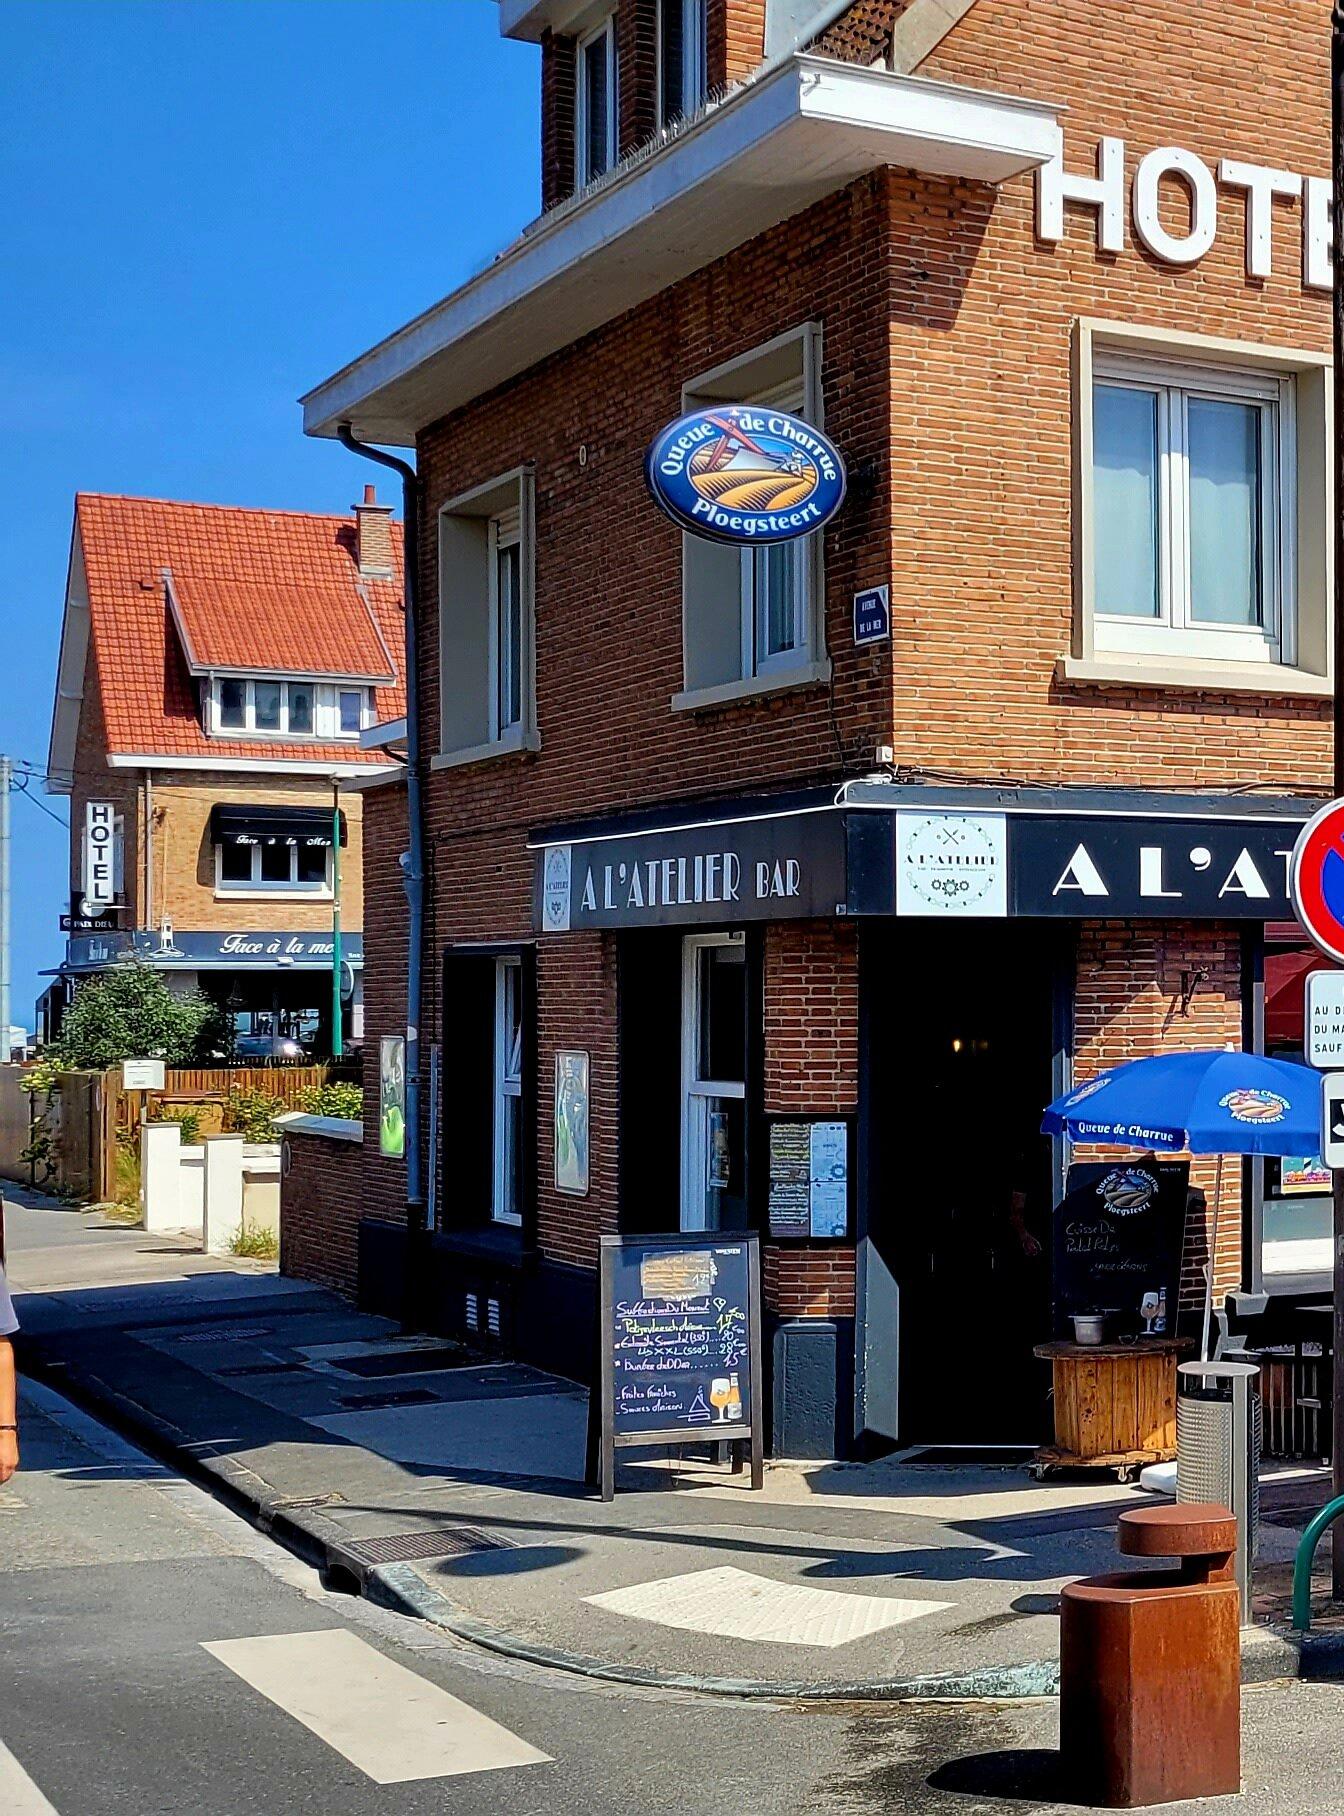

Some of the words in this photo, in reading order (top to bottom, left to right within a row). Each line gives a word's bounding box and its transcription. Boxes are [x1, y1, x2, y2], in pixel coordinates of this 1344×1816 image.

[661, 423, 715, 476] Queue
[739, 413, 765, 431] de
[768, 417, 837, 481] Charrue
[691, 497, 822, 536] Ploegsteert
[91, 806, 110, 899] HOTEL
[1052, 842, 1110, 896] A
[581, 865, 597, 912] A
[604, 852, 740, 910] L'ATELIER
[756, 859, 801, 899] BAR
[219, 934, 263, 954] Face
[267, 938, 282, 954] à
[286, 936, 305, 954] la
[308, 943, 335, 954] me
[1314, 1006, 1328, 1016] AU
[1314, 1025, 1328, 1034] DU
[1314, 1043, 1342, 1053] SAUF
[1078, 1122, 1110, 1134] Queue
[1113, 1124, 1126, 1134] de
[1128, 1126, 1174, 1142] Charrue
[1126, 1168, 1136, 1176] de
[1104, 1202, 1151, 1216] Ploegsteert
